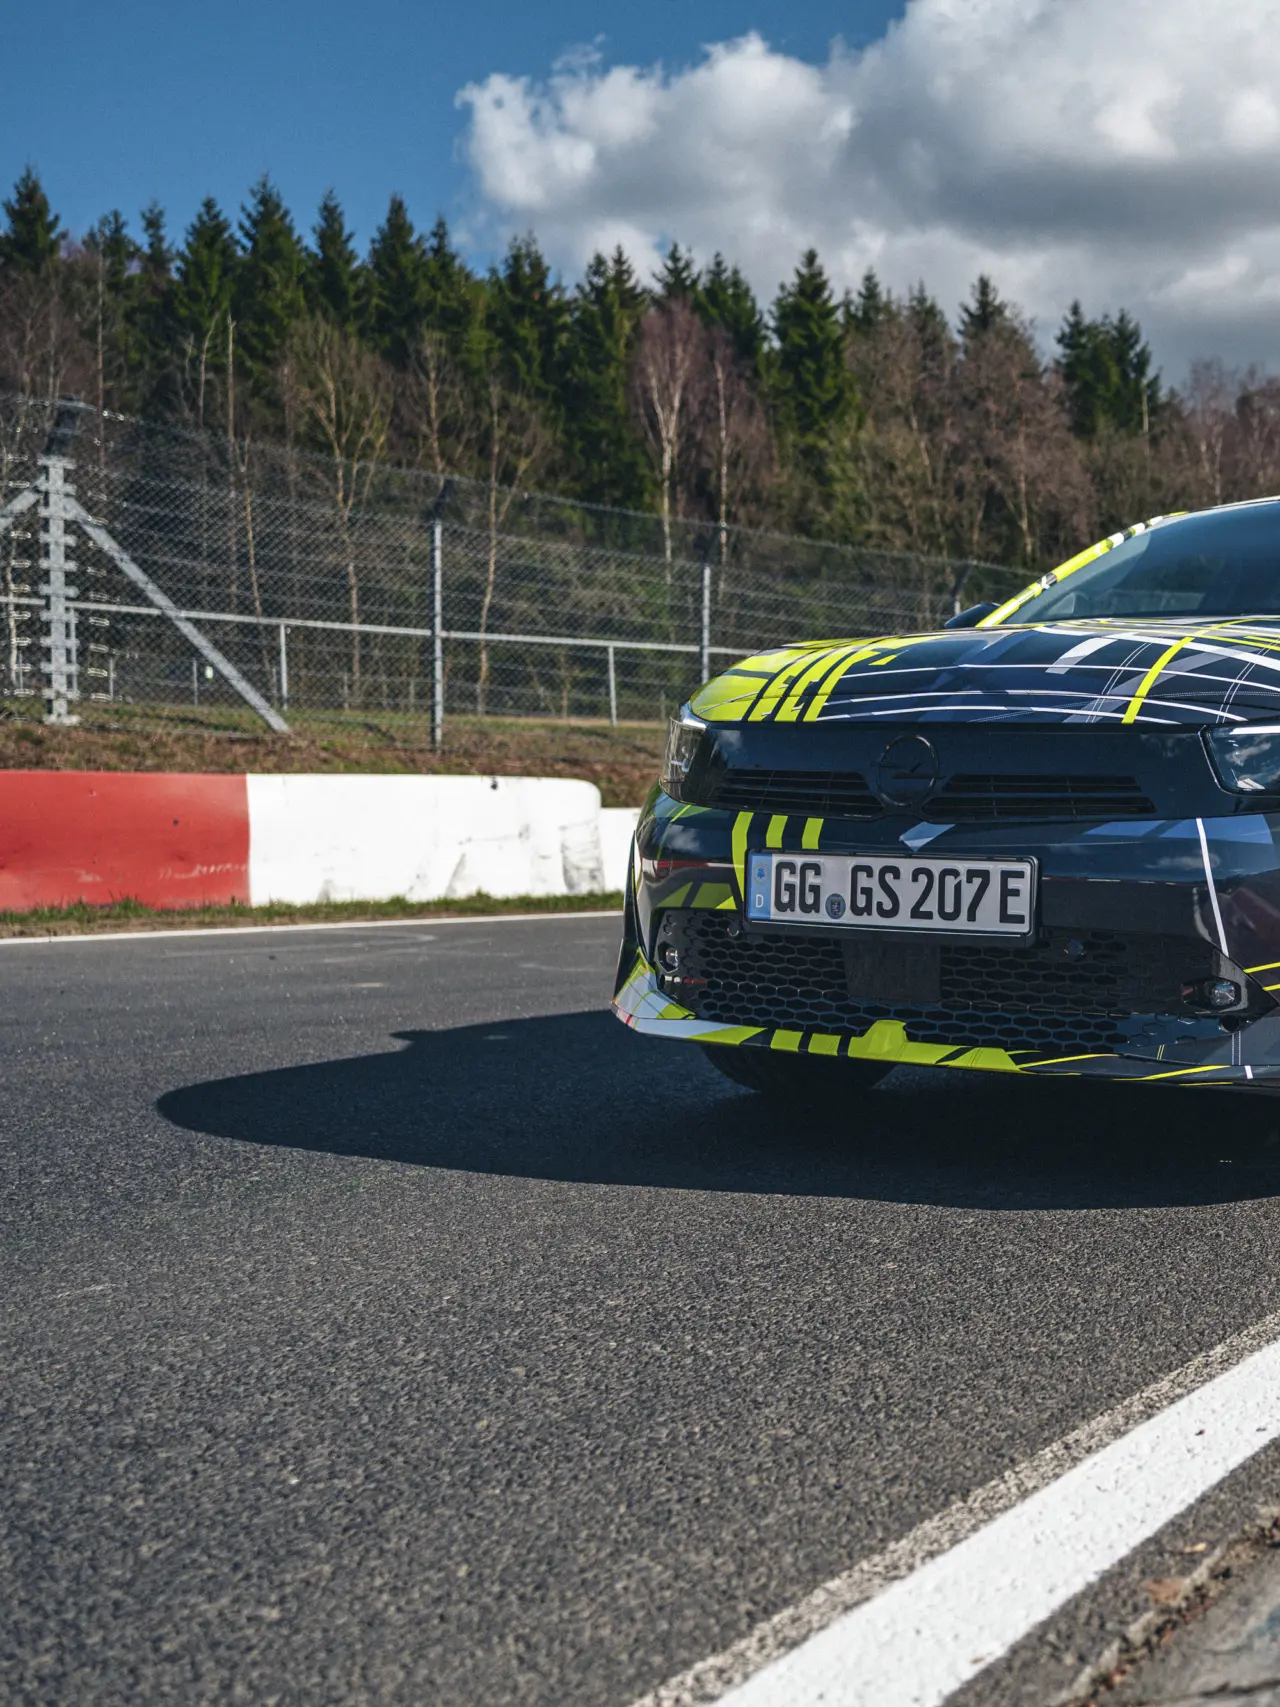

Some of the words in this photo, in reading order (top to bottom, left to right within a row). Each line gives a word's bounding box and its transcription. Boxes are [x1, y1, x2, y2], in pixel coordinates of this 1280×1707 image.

[755, 893, 764, 908] D
[774, 861, 821, 914] GG
[850, 864, 901, 918] GS
